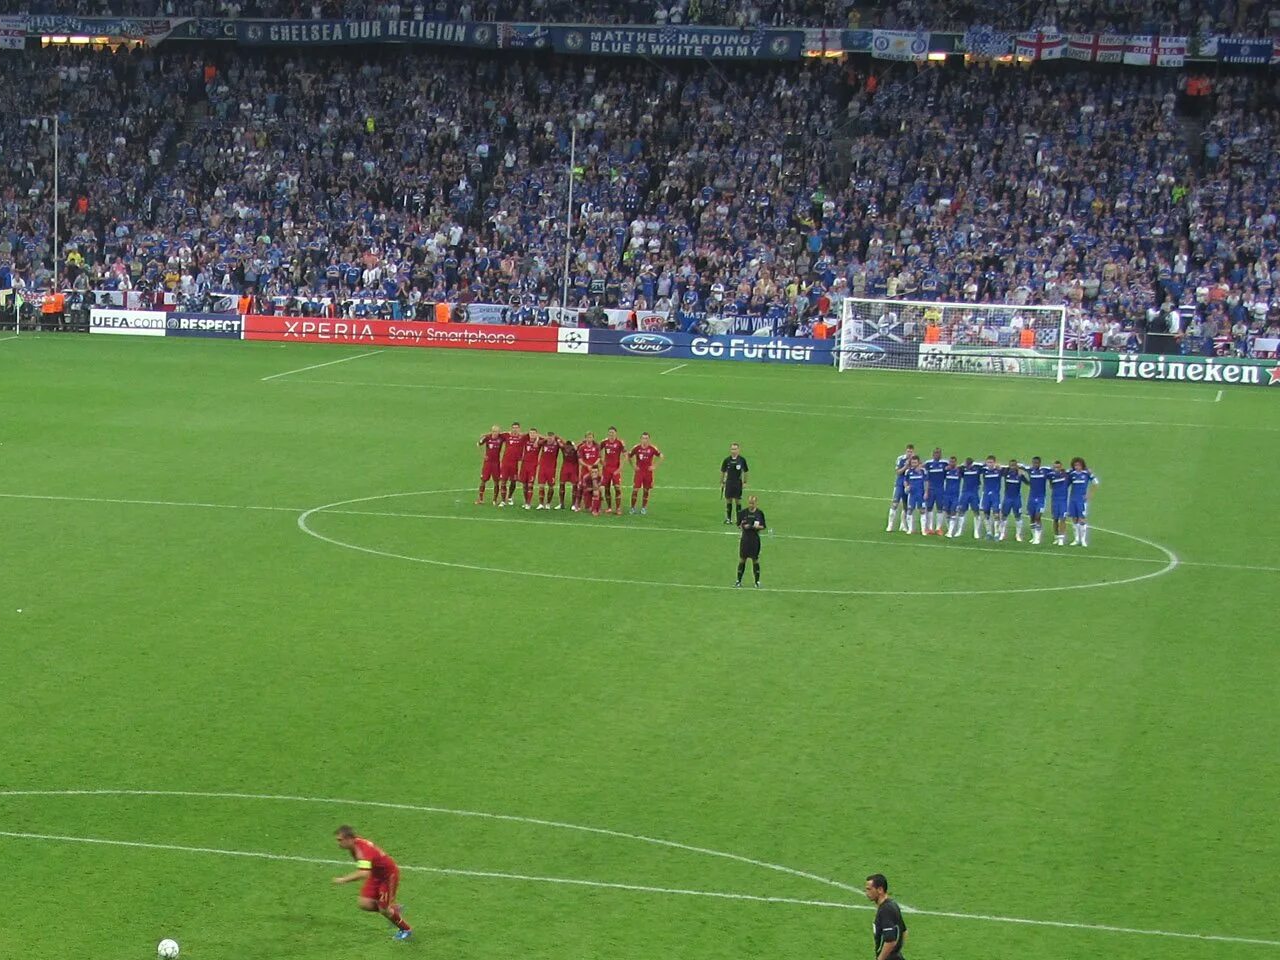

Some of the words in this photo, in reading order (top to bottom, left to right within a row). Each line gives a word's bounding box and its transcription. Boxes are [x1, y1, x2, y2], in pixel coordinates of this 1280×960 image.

[270, 24, 343, 41] CHELSEA
[349, 21, 381, 39] OUR
[388, 20, 466, 42] RELIGION
[590, 31, 675, 43] MATTHE
[678, 33, 750, 45] HARDING
[590, 42, 631, 53] BLUE
[637, 44, 645, 54] &
[651, 44, 703, 56] WHITE
[712, 46, 761, 57] ARMY
[1133, 46, 1178, 54] CHELSEA
[179, 319, 241, 333] RESPECT
[283, 321, 374, 341] XPERIA
[388, 326, 423, 343] Sony
[426, 328, 516, 345] Smartphone
[629, 336, 664, 350] Ford
[690, 337, 724, 357] Go
[729, 338, 815, 361] Further
[1116, 354, 1261, 383] Heineken
